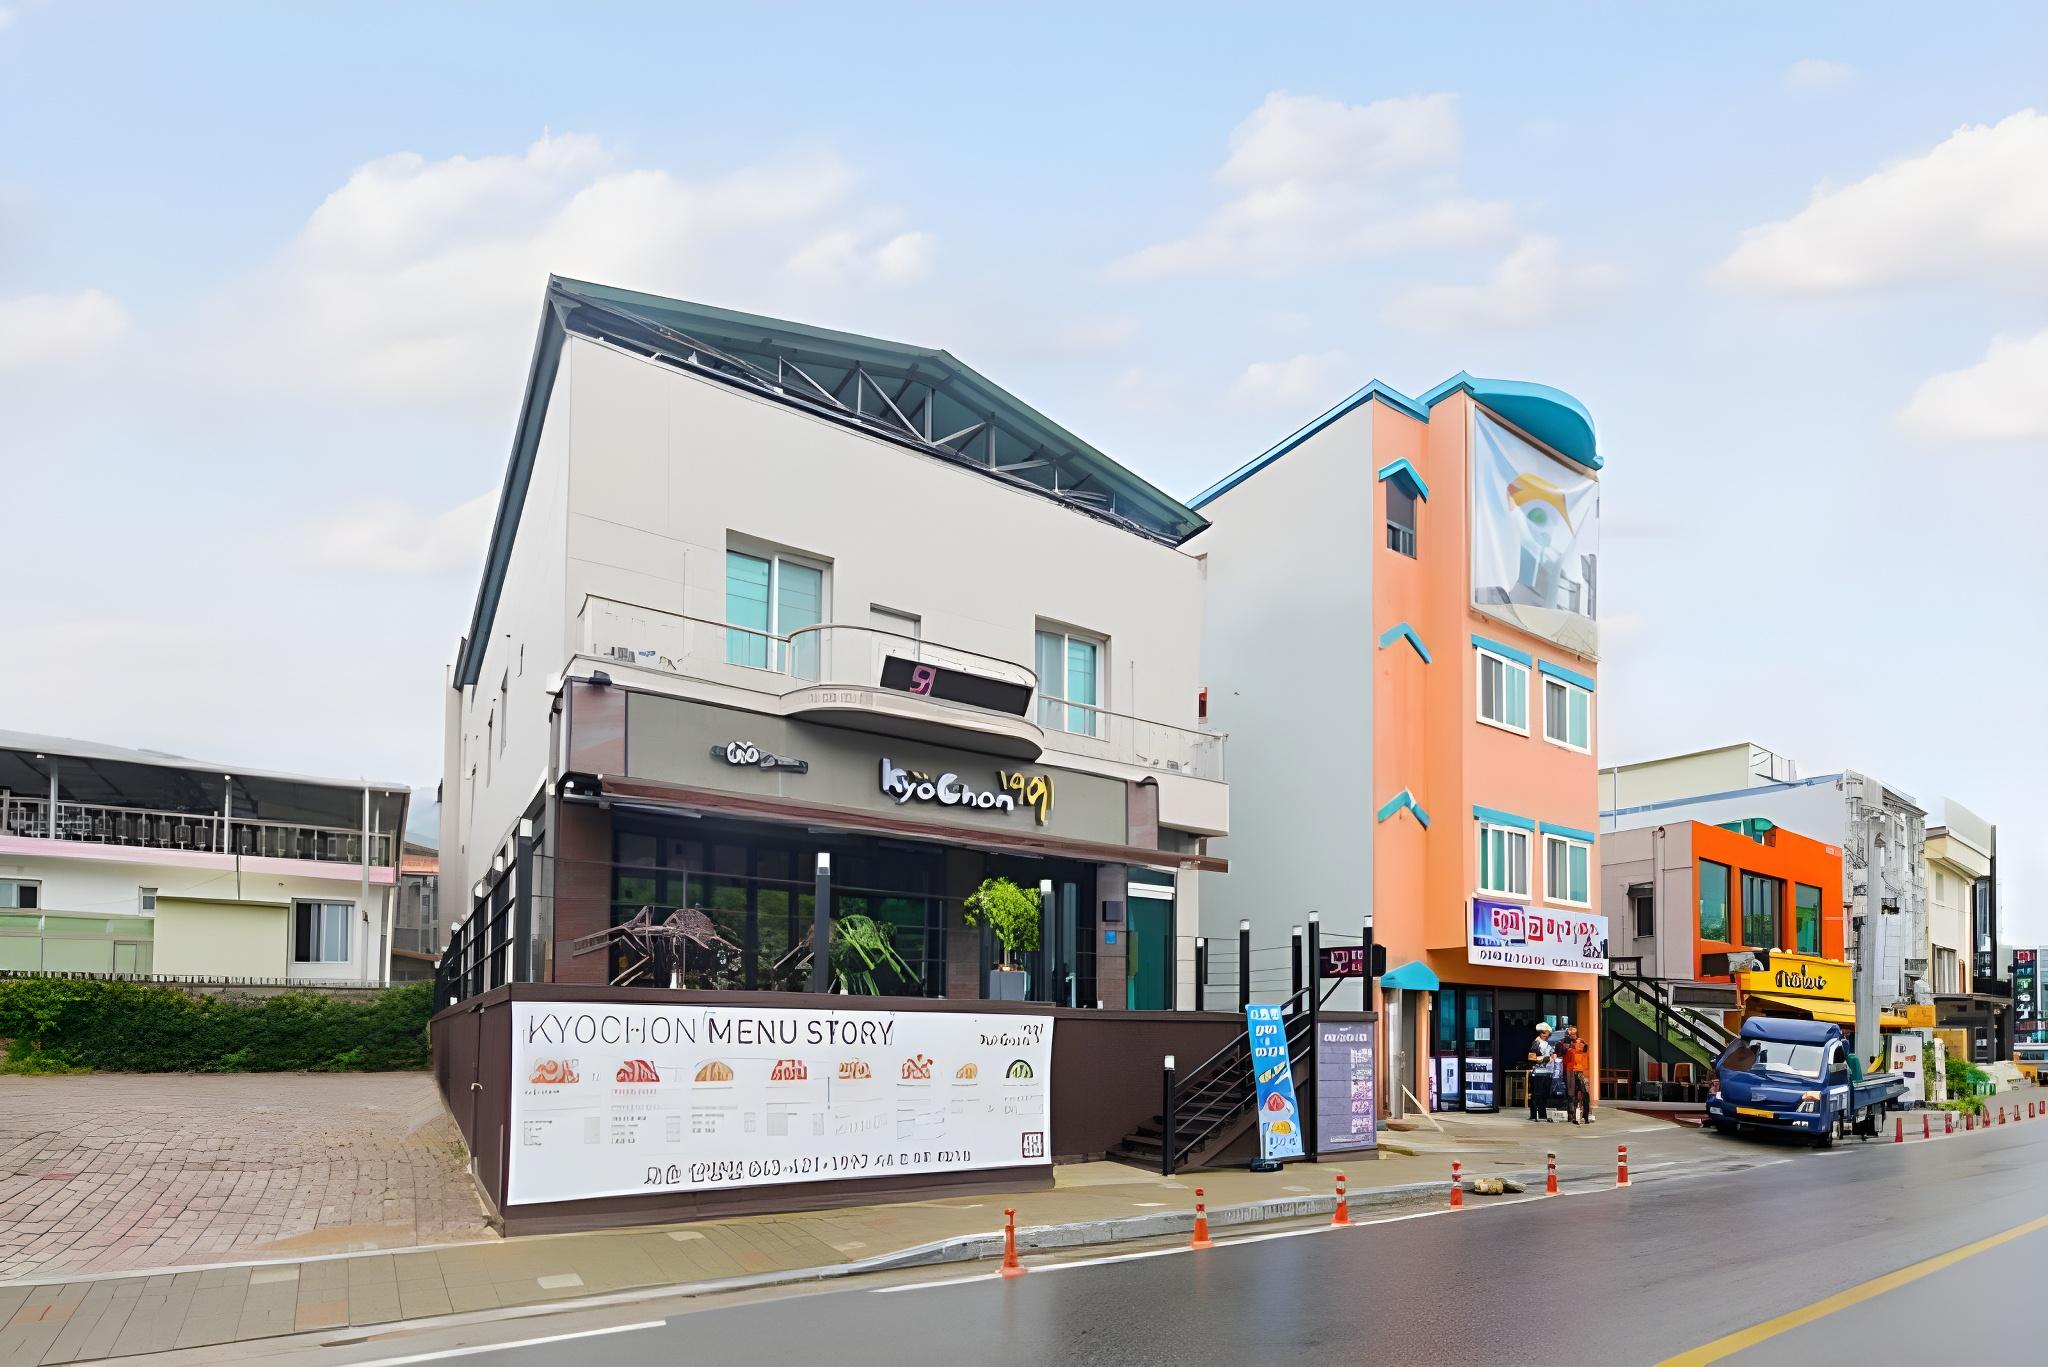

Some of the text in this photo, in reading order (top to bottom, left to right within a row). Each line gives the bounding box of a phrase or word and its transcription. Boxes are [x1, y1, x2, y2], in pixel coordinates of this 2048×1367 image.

[528, 1013, 895, 1046] KYOCHON MENU STORY
